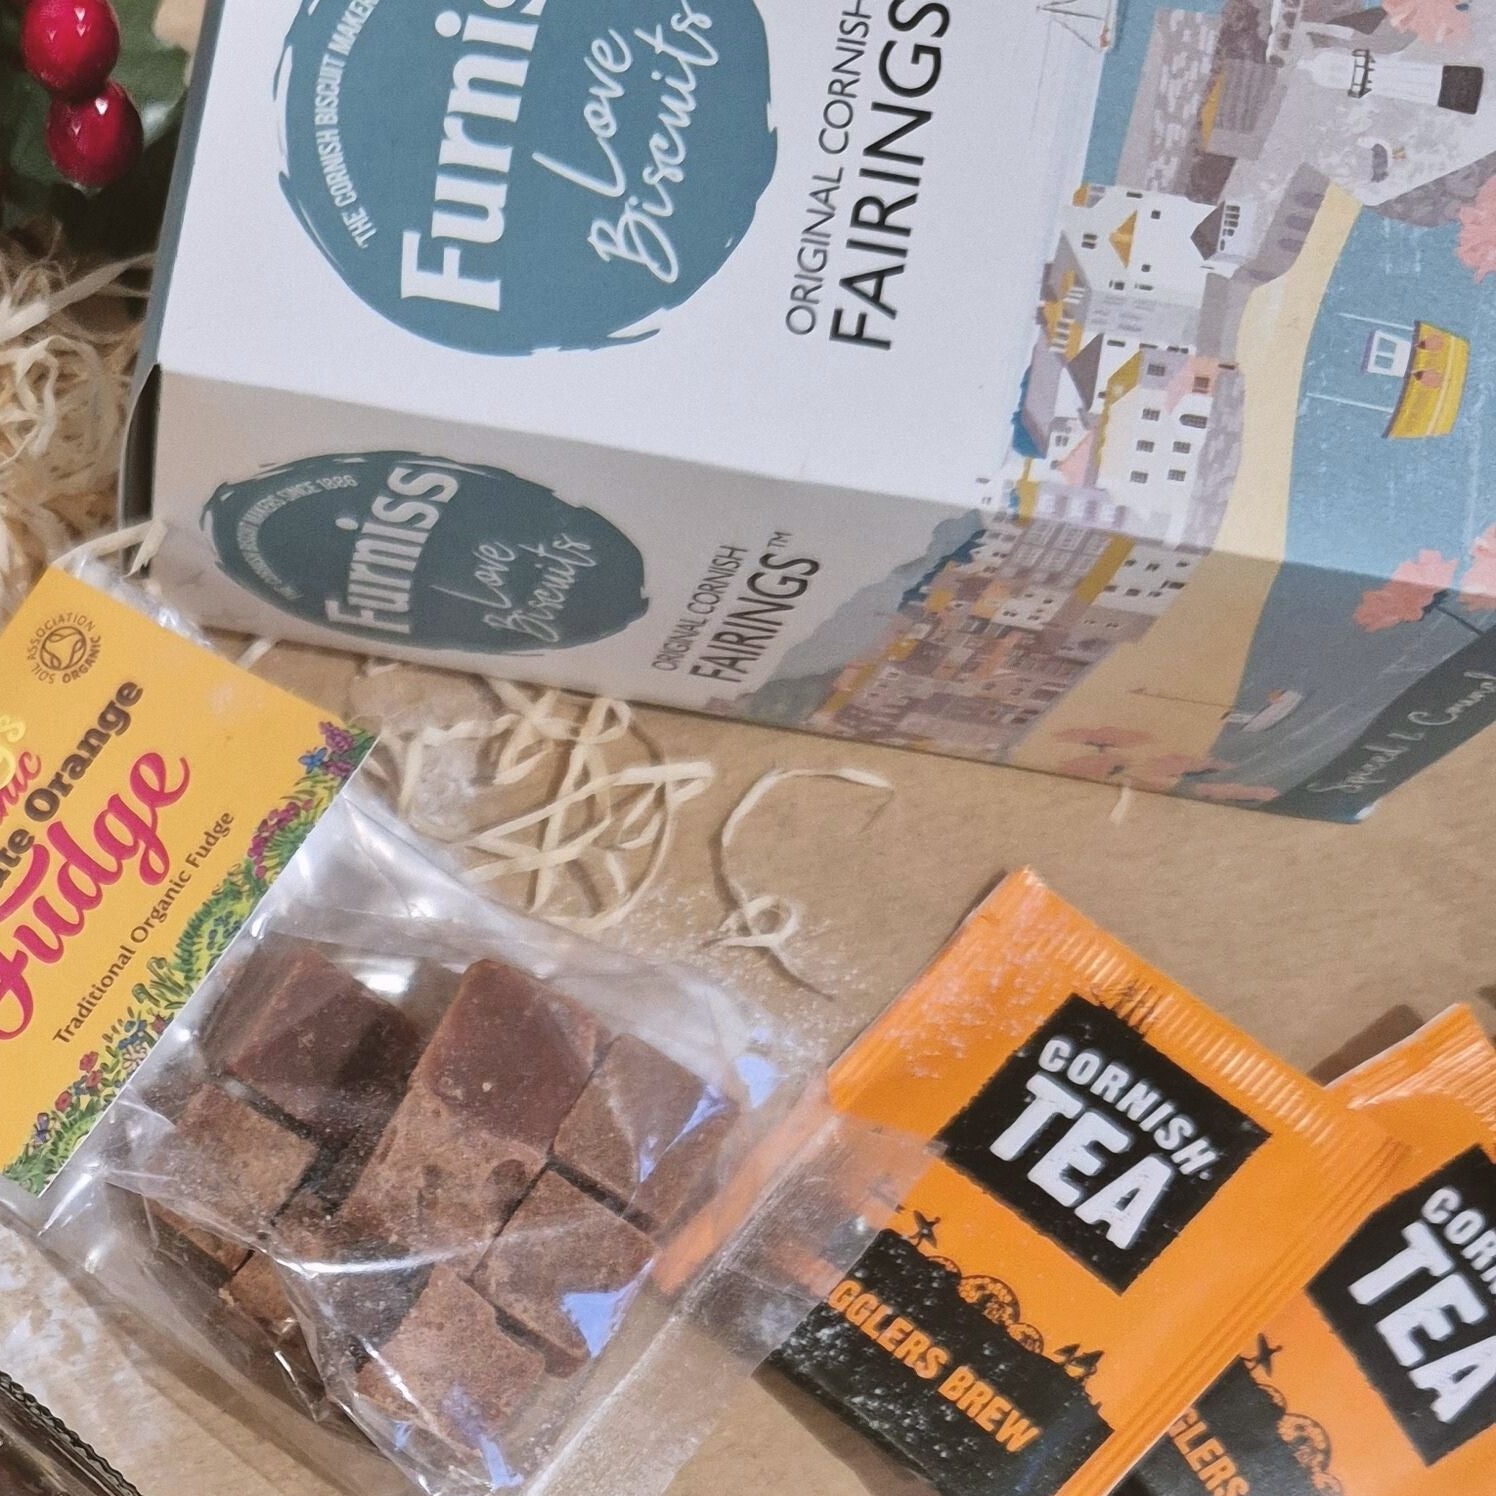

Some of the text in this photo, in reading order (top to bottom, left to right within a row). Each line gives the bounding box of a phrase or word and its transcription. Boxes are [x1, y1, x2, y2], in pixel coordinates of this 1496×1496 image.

[315, 0, 380, 249] THE CORNISH BISCUIT MAKE
[532, 29, 633, 197] Love
[587, 0, 719, 283] Biscuits
[829, 0, 951, 351] FAIRINGS
[785, 167, 844, 335] ORIGINAL
[324, 467, 459, 634] Furniss
[428, 541, 516, 609] Love
[482, 532, 597, 643] Biscuits
[651, 545, 748, 672] ORIGINAL CORNISH
[27, 612, 96, 684] SOIL ASSOCIATION
[62, 635, 102, 684] ORGANIC
[24, 681, 144, 823] Orange
[52, 812, 235, 1045] Traditional Organic Fudge
[989, 1072, 1175, 1251] TEA
[1038, 1037, 1218, 1176] CORNISH
[827, 1279, 1042, 1453] GGLERS BREW
[1347, 1218, 1496, 1425] TEA
